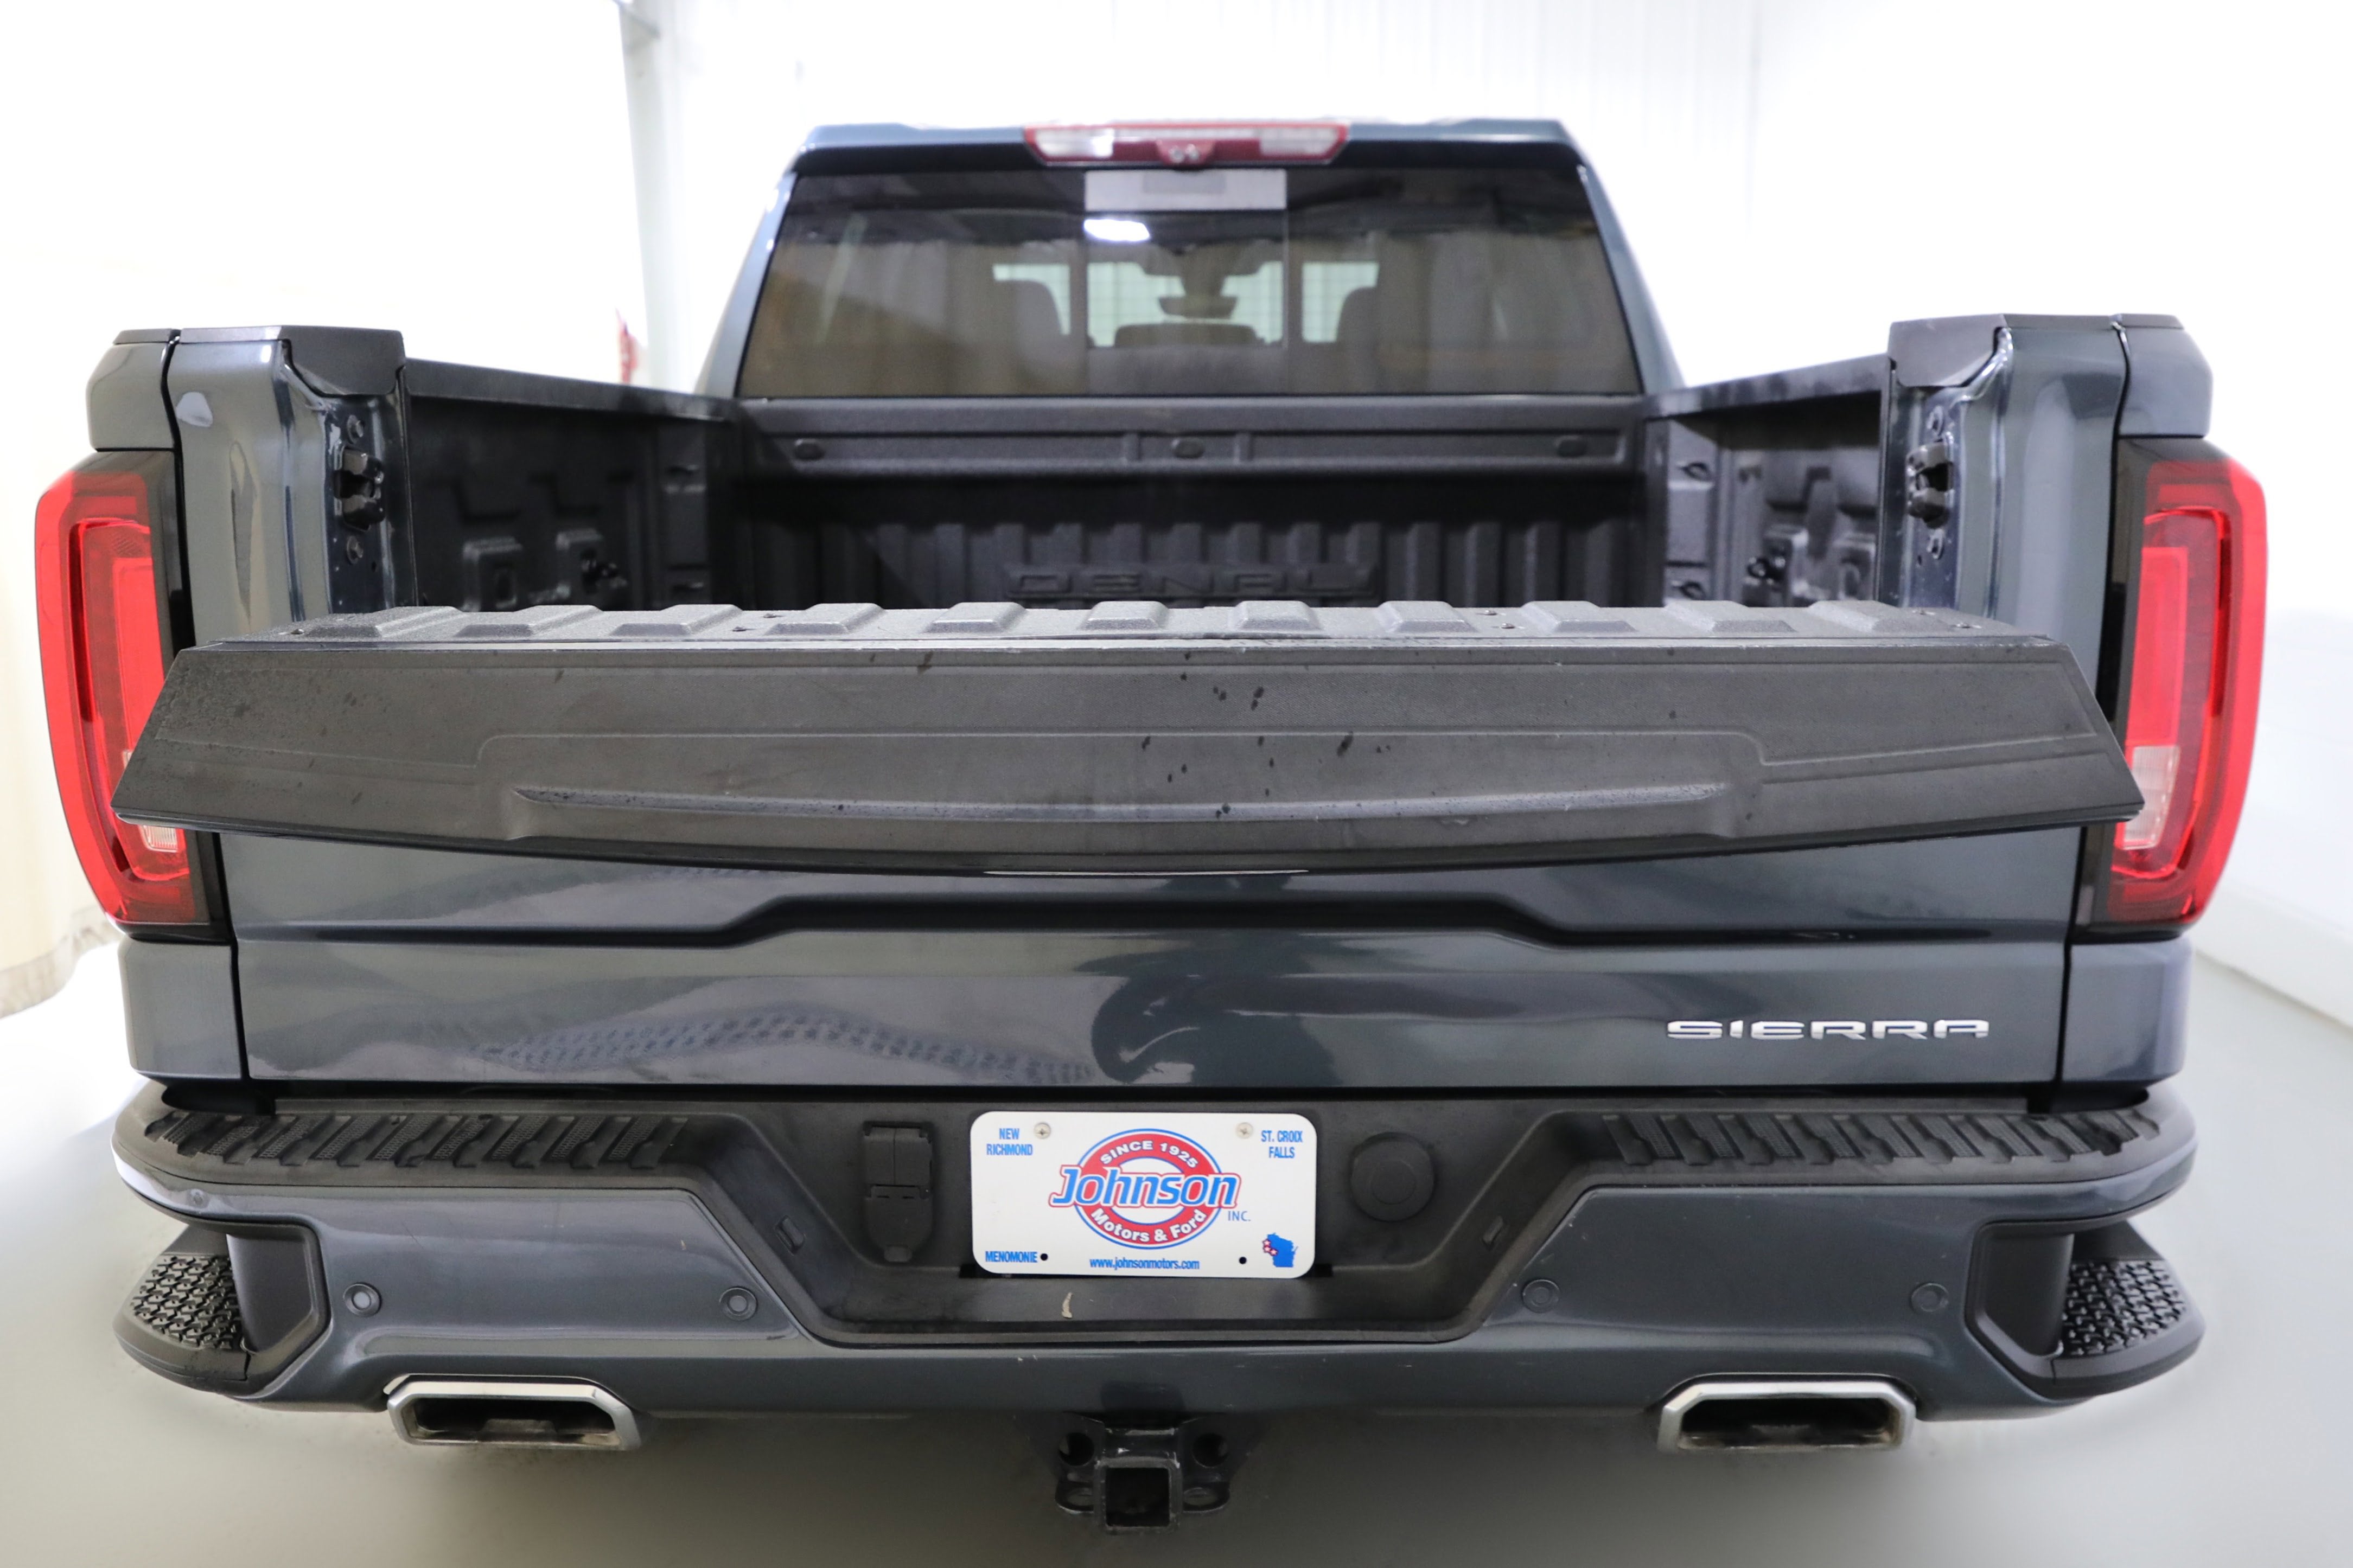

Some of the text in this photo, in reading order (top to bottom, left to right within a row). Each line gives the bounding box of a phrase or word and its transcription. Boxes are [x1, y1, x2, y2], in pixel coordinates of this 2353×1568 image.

[1667, 1020, 1989, 1040] SIERRA
[999, 1128, 1019, 1140] NEW
[1261, 1130, 1303, 1142] ST. CROIX
[986, 1144, 1033, 1156] RICHMOND
[1100, 1140, 1198, 1168] SINCE 1925
[1268, 1146, 1295, 1159] FALLS
[1051, 1168, 1238, 1206] Johnson
[1227, 1211, 1251, 1222] INC.
[1091, 1207, 1207, 1243] Motors & Ford
[985, 1251, 1038, 1263] MENOMONIE
[1089, 1257, 1200, 1270] www.johnsonmotors.com
